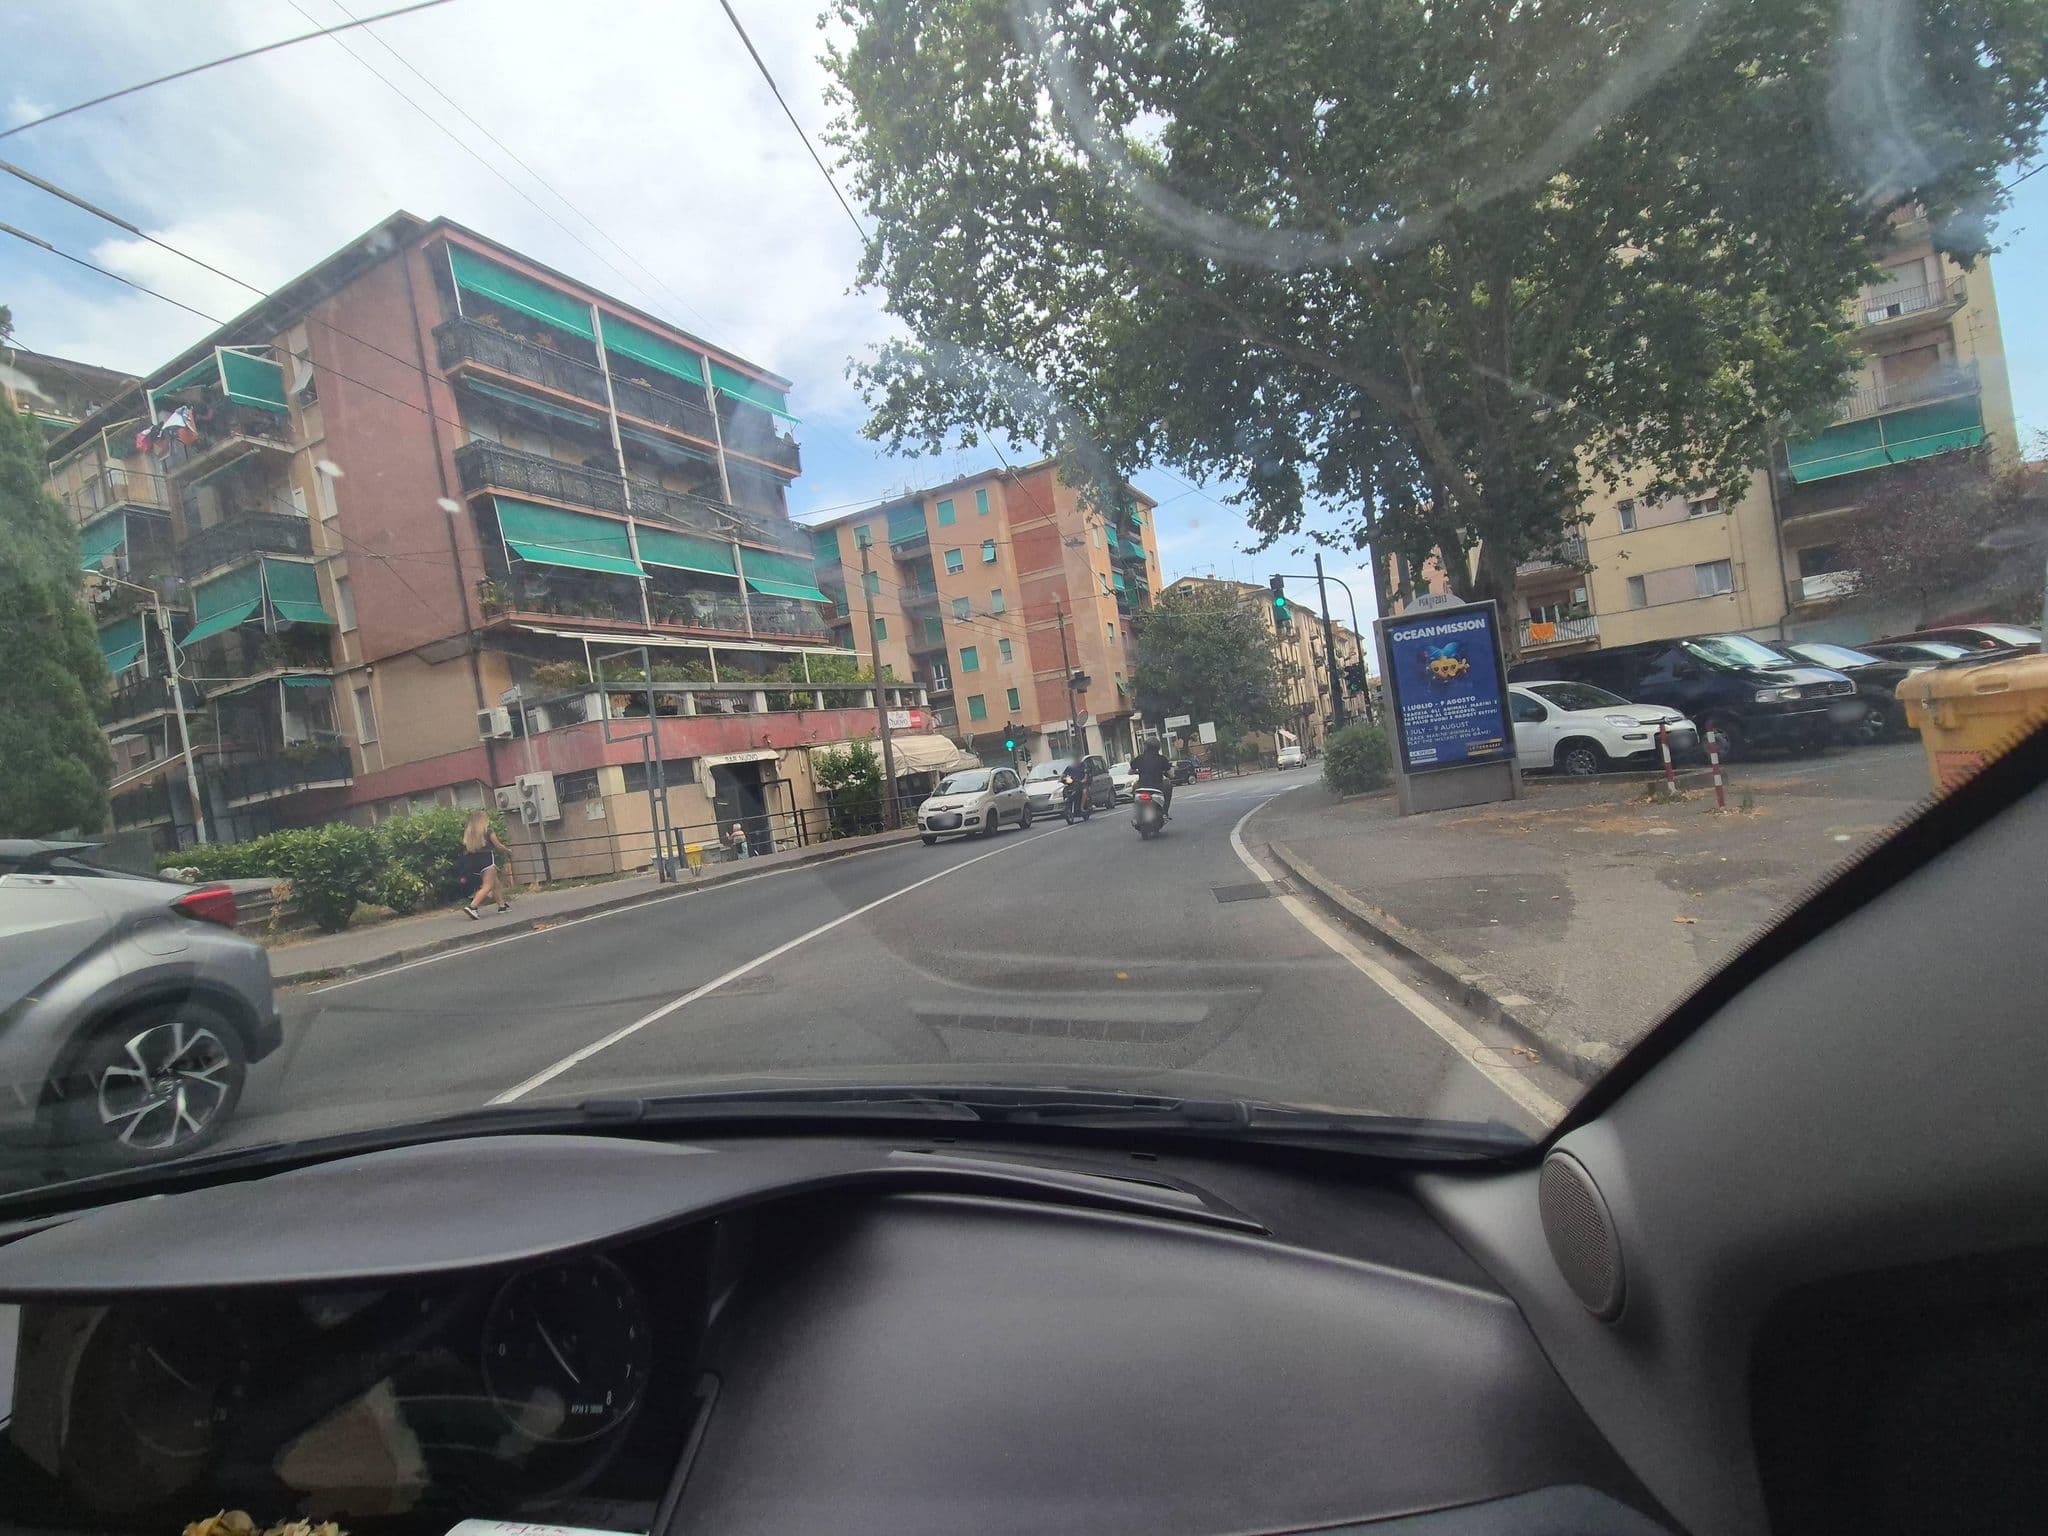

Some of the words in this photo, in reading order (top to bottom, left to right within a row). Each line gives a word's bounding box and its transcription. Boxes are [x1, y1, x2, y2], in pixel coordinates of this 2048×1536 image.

[1407, 702, 1433, 712] LUGLIO
[1446, 696, 1476, 705] AGOSTO
[1410, 727, 1426, 736] JULY
[1440, 720, 1469, 731] AUGUST
[498, 1343, 506, 1357] 0
[625, 1364, 632, 1379] 7
[606, 1390, 613, 1406] 8
